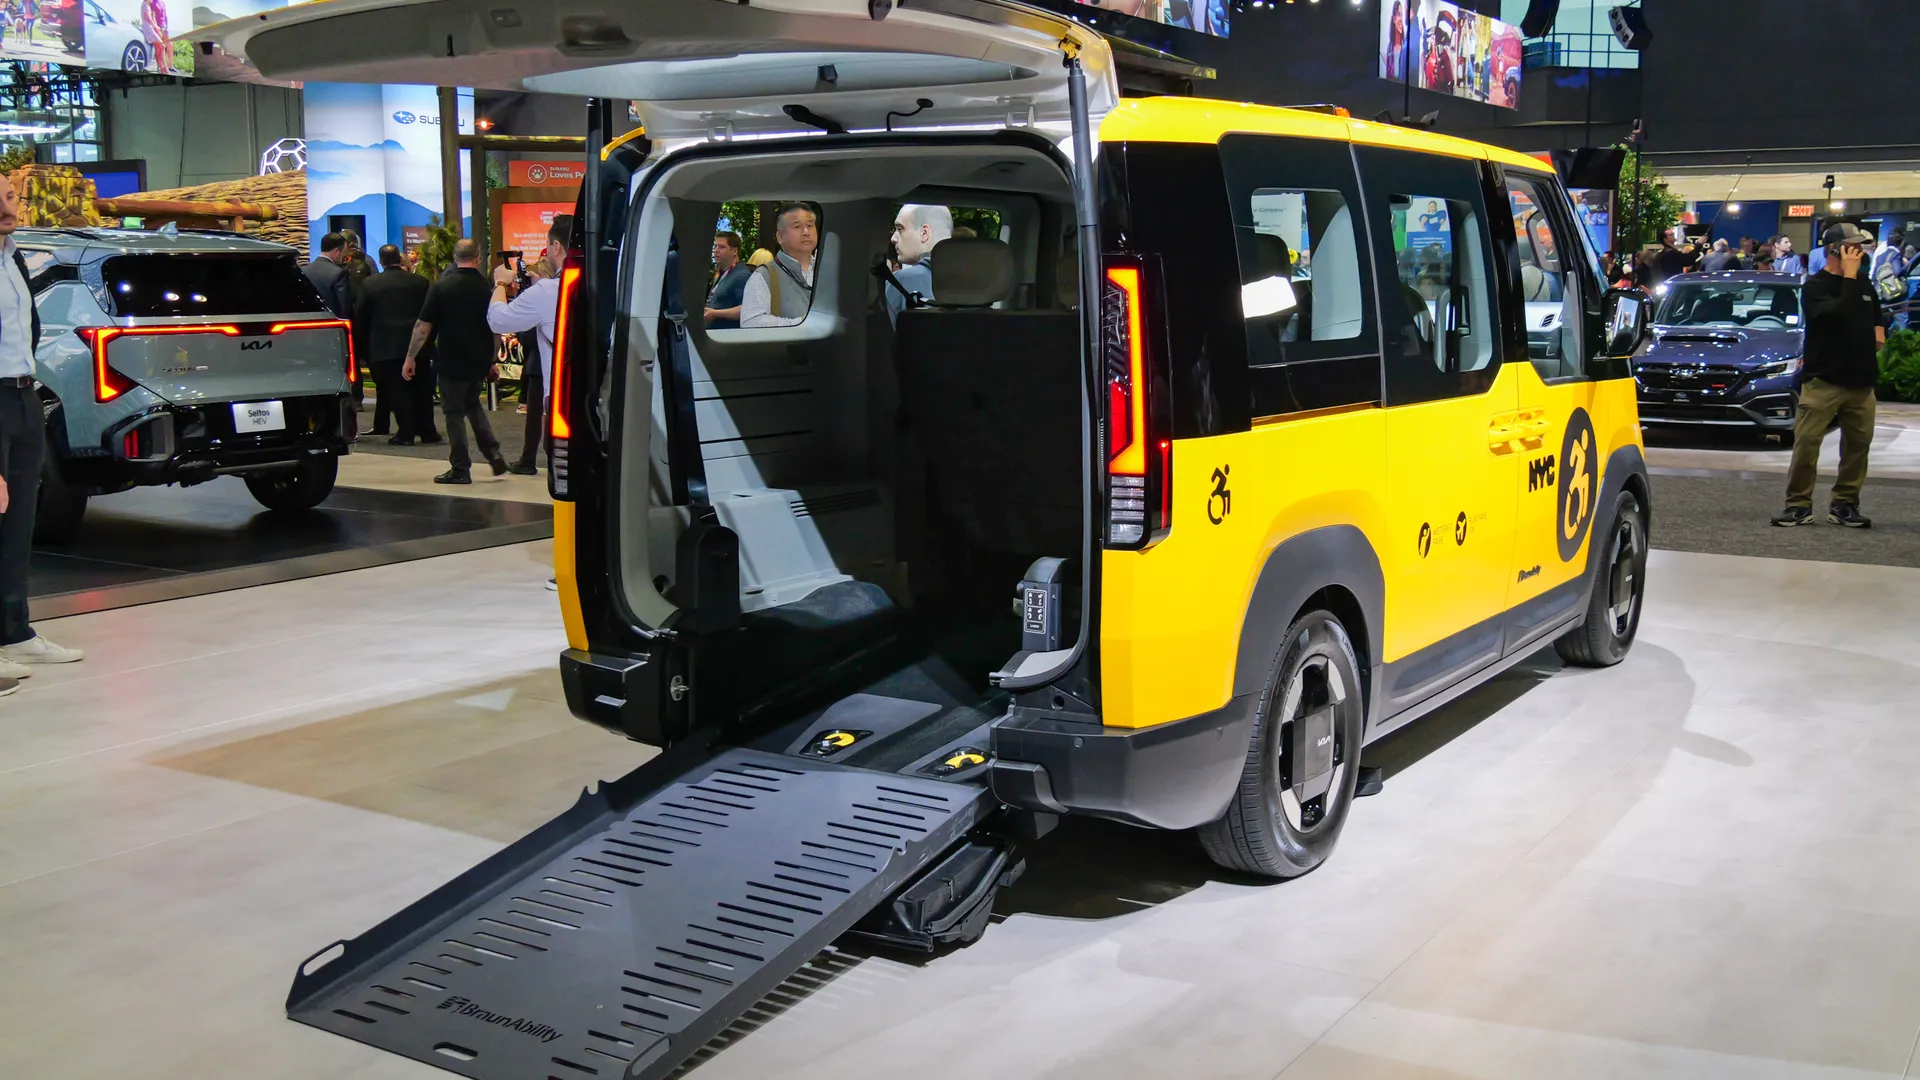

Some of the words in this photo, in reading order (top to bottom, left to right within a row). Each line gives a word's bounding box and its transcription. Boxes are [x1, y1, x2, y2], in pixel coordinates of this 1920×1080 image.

[420, 115, 465, 127] SUBU
[549, 171, 574, 179] Loves
[1789, 205, 1814, 216] EXIT
[241, 340, 272, 350] KIA
[247, 409, 270, 417] Seltos
[252, 417, 268, 425] HEV
[1529, 454, 1555, 492] NYC
[1318, 735, 1331, 747] KIA
[459, 1003, 564, 1043] BraunAbility
